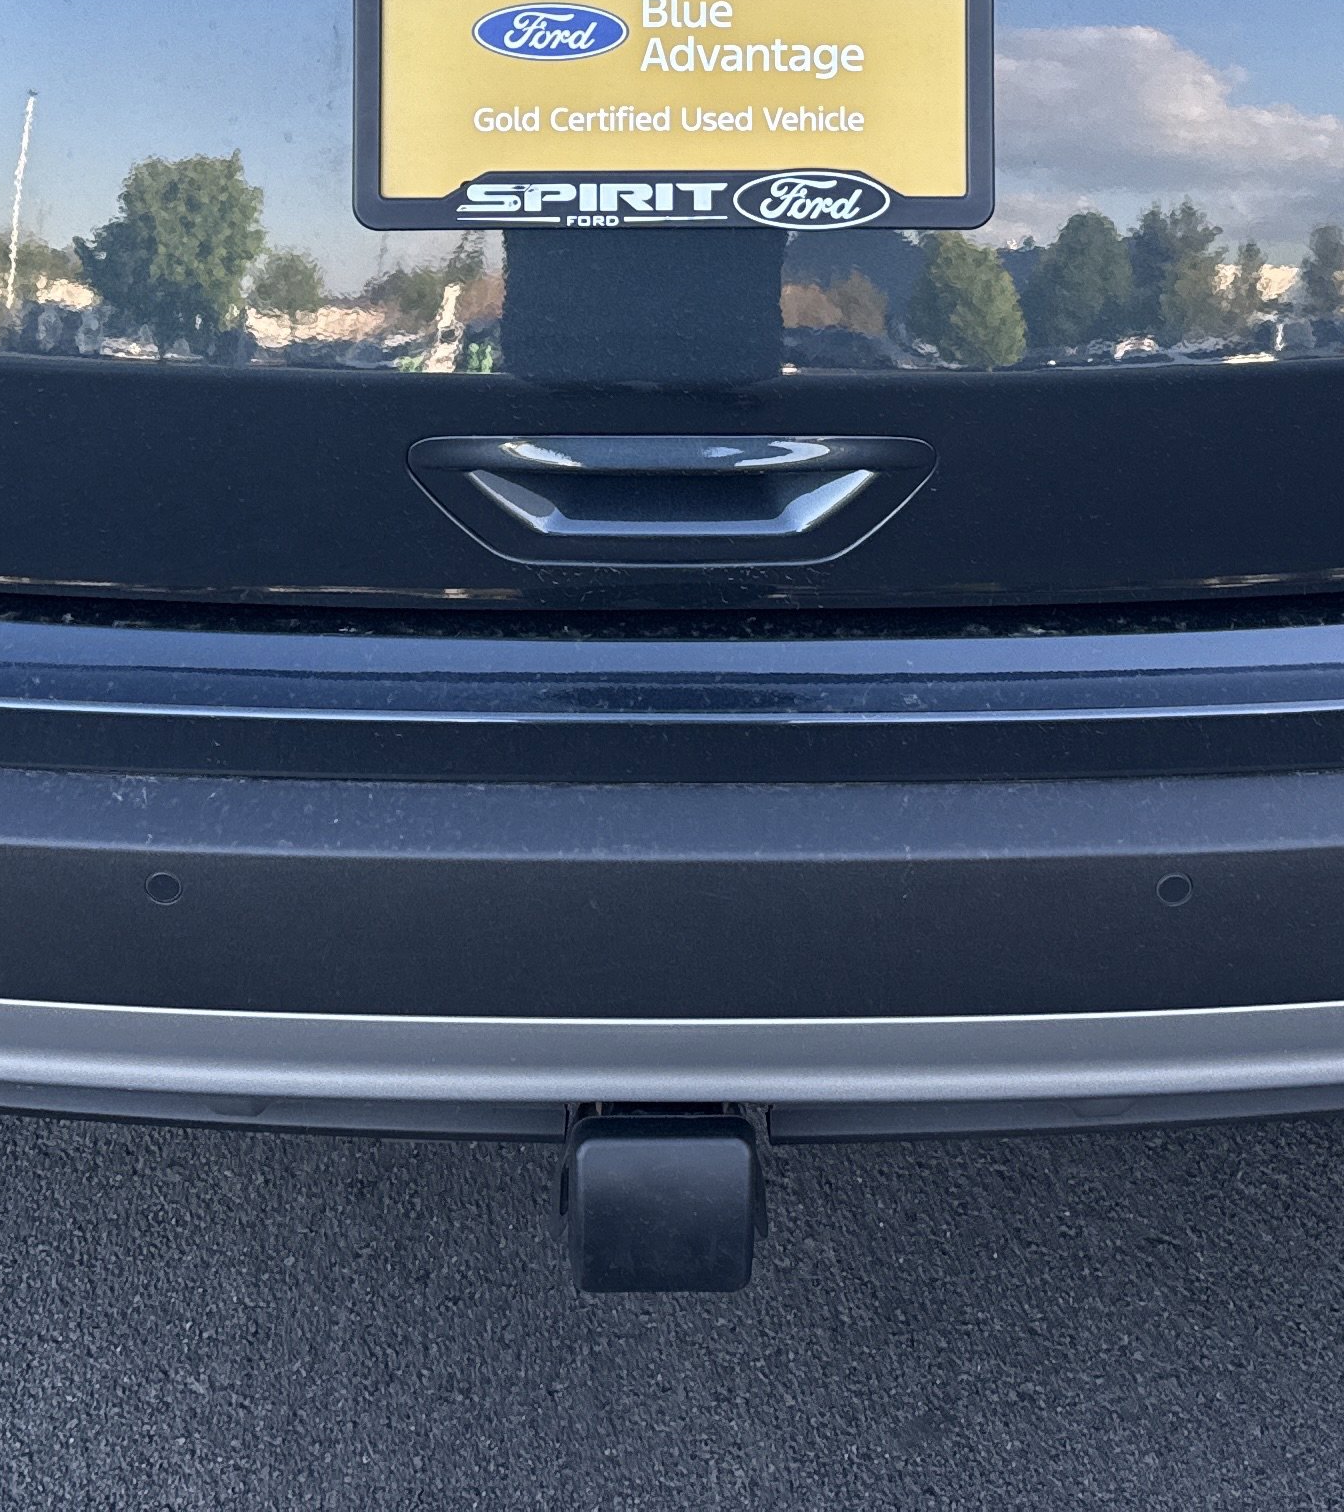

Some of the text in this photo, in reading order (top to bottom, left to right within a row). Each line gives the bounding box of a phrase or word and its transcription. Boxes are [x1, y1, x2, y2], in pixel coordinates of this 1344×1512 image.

[503, 12, 596, 50] Ford
[640, 35, 865, 79] Advantage
[473, 106, 865, 132] Gold Certified Used Vehicle
[457, 178, 862, 220] SPIRIT Ford
[566, 216, 619, 226] FORD
